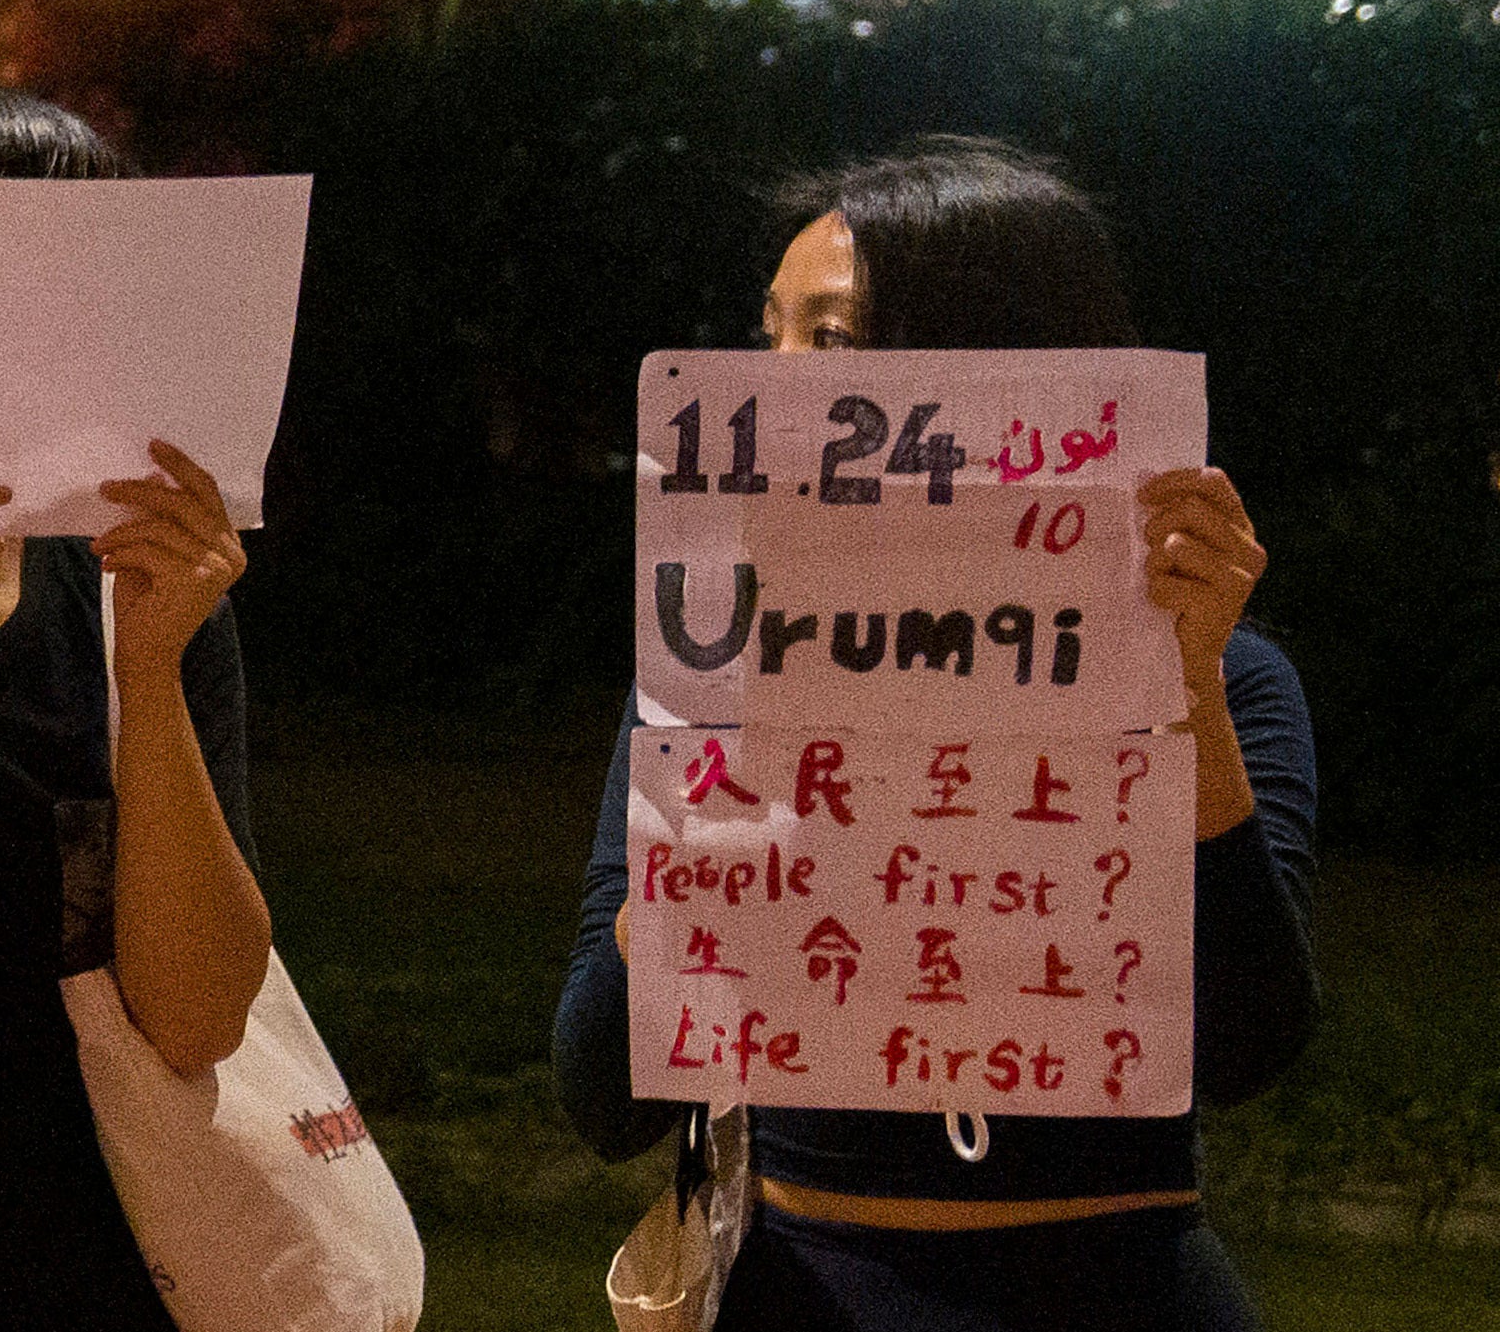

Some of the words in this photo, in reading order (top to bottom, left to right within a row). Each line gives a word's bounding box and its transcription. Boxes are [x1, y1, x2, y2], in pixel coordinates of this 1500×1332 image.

[659, 394, 967, 507] 11.24
[1013, 501, 1087, 556] 10
[654, 561, 1084, 687] Urumqi
[642, 840, 817, 906] People
[666, 1004, 810, 1086] Life
